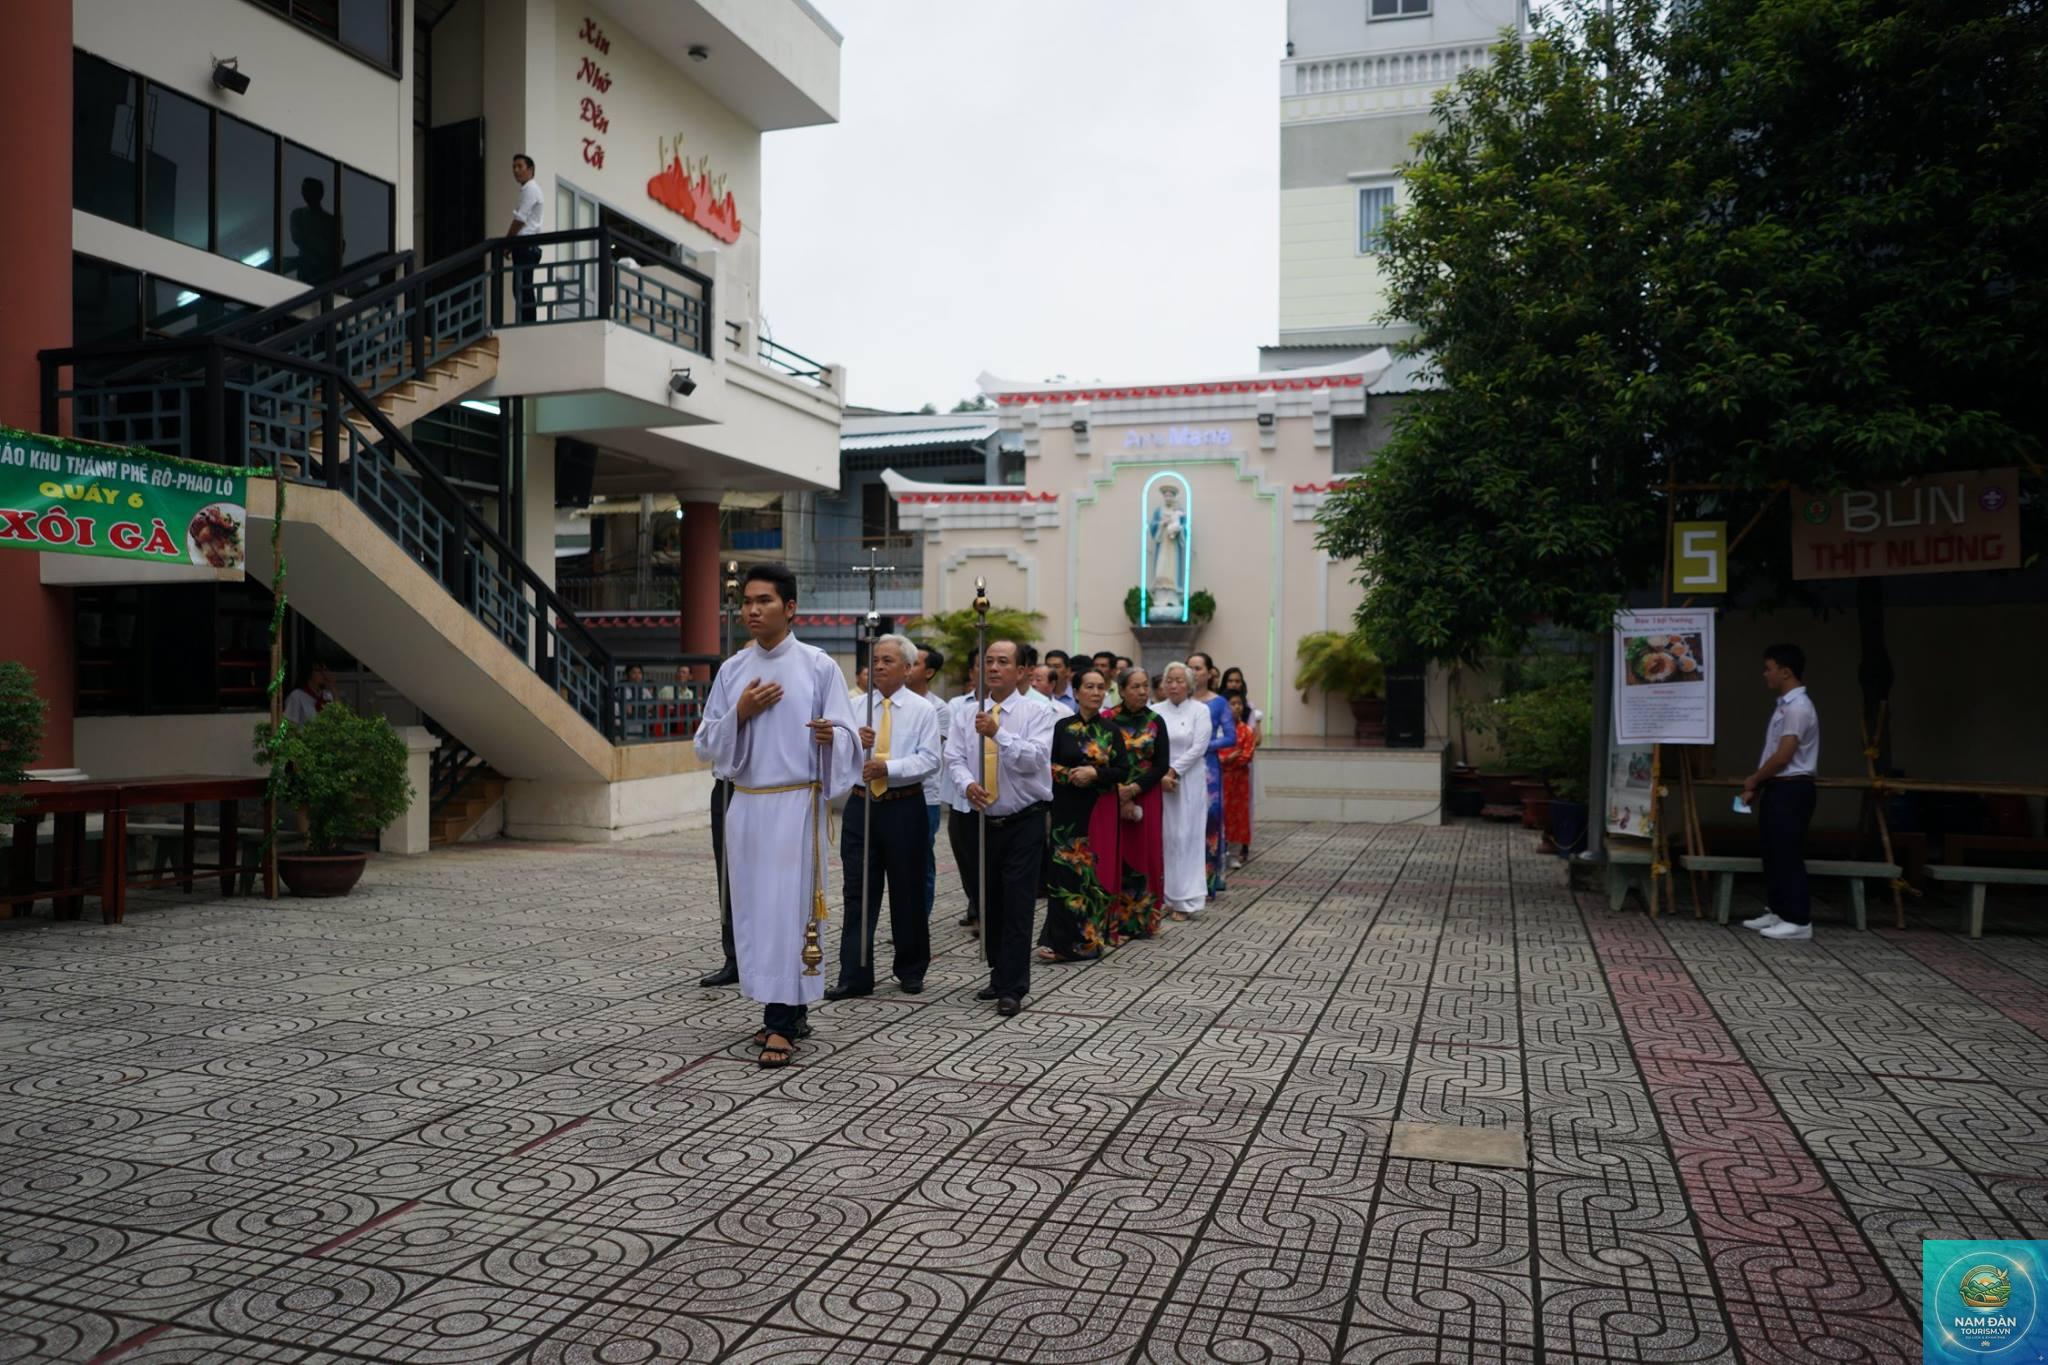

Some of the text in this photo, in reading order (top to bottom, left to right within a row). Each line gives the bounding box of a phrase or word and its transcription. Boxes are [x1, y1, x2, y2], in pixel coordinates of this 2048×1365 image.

[579, 17, 610, 55] Xin
[0, 441, 25, 467] ÁO
[30, 450, 60, 472] KHU
[65, 455, 116, 480] THÁNH
[216, 477, 233, 496] LÔ
[128, 492, 144, 508] 6
[1842, 475, 1965, 533] BÚN
[0, 505, 180, 556] XÔI GÀ
[1809, 538, 1876, 574] THỊT
[1682, 530, 1718, 585] 5
